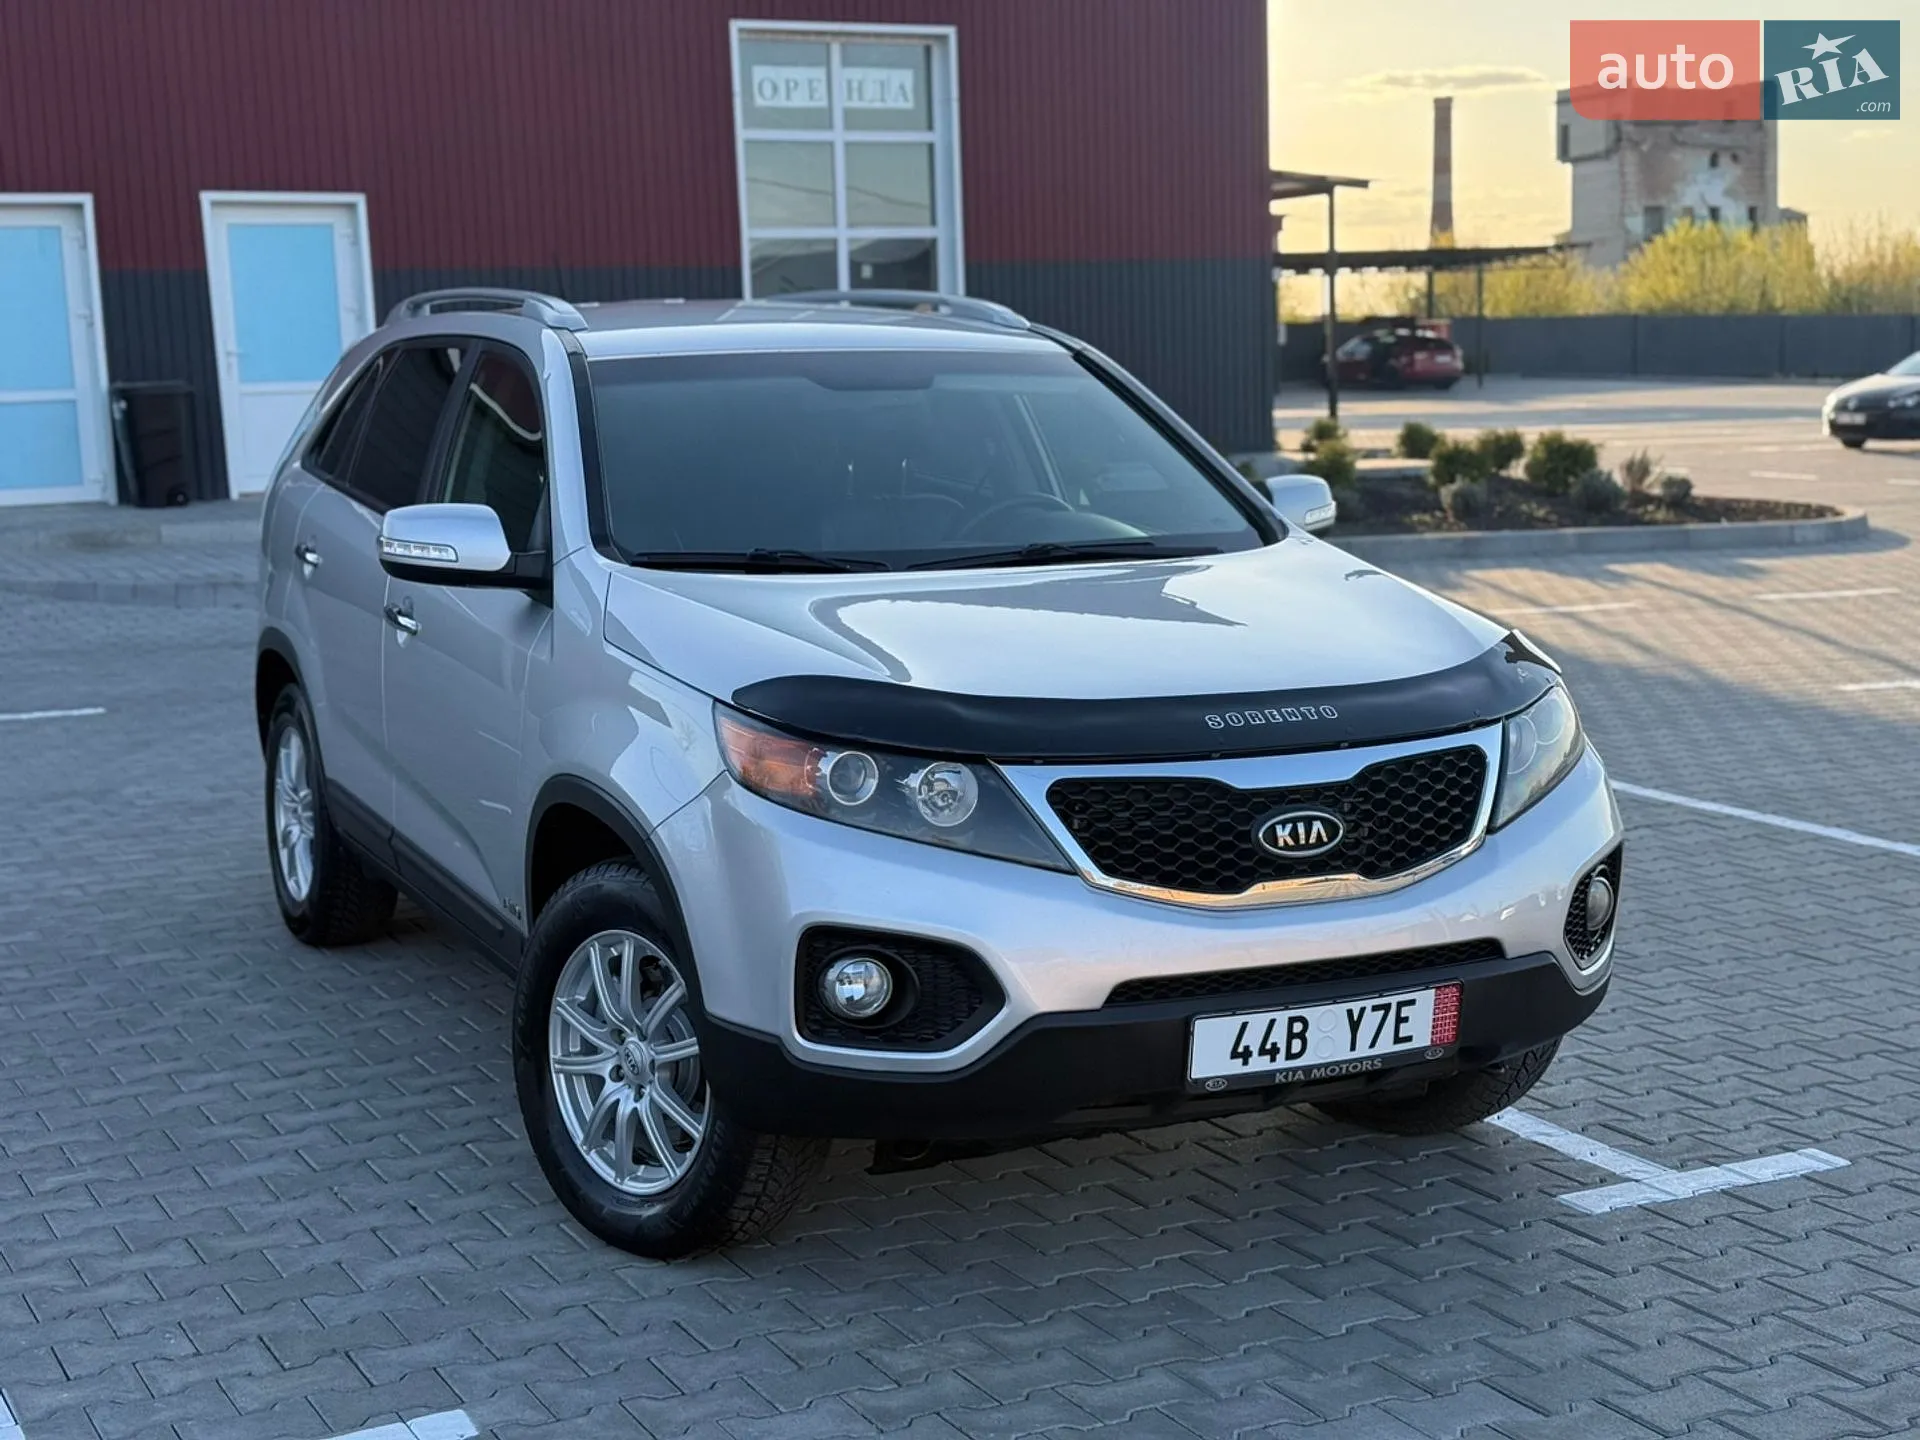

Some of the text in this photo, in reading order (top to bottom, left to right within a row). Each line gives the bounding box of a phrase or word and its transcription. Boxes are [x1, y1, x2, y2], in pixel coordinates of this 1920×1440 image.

[1204, 705, 1339, 729] SORENTO
[1274, 820, 1329, 847] KIA
[1229, 1015, 1310, 1067] 44B
[1346, 998, 1418, 1053] Y7E
[1274, 1057, 1384, 1084] KIA MOTORS
